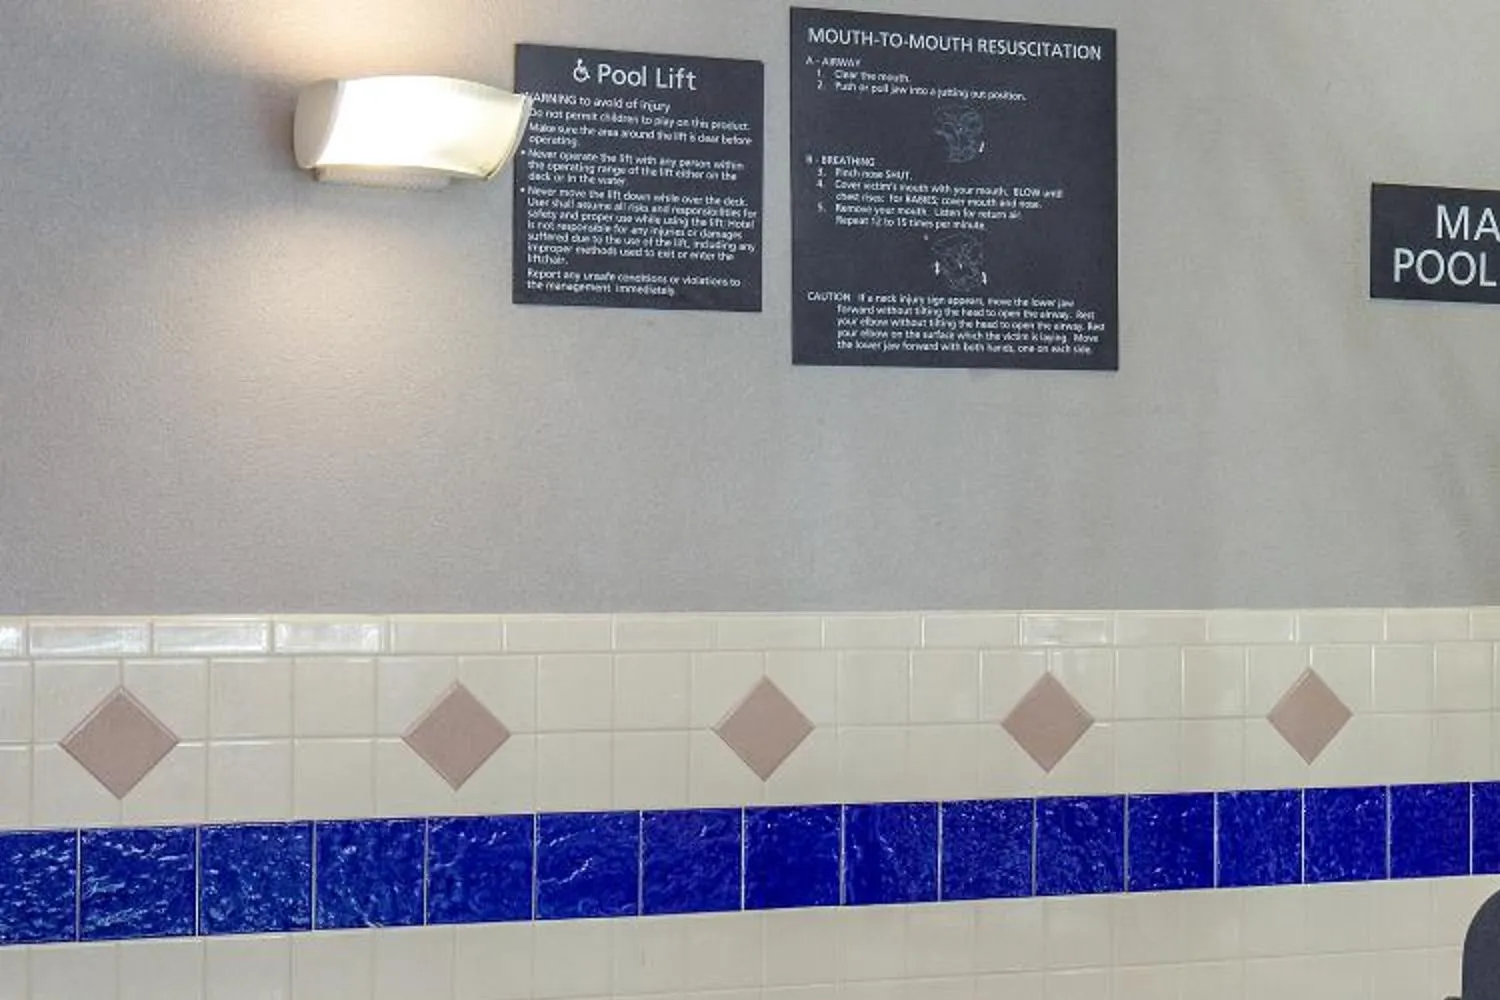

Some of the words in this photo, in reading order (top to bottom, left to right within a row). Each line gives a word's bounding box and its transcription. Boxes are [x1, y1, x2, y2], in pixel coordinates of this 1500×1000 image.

[808, 27, 972, 52] MOUTH-TO-MOUTH
[977, 38, 1101, 60] RESUSCITATION
[598, 63, 646, 86] Pool
[656, 66, 696, 90] Lift
[1393, 247, 1497, 287] POOL
